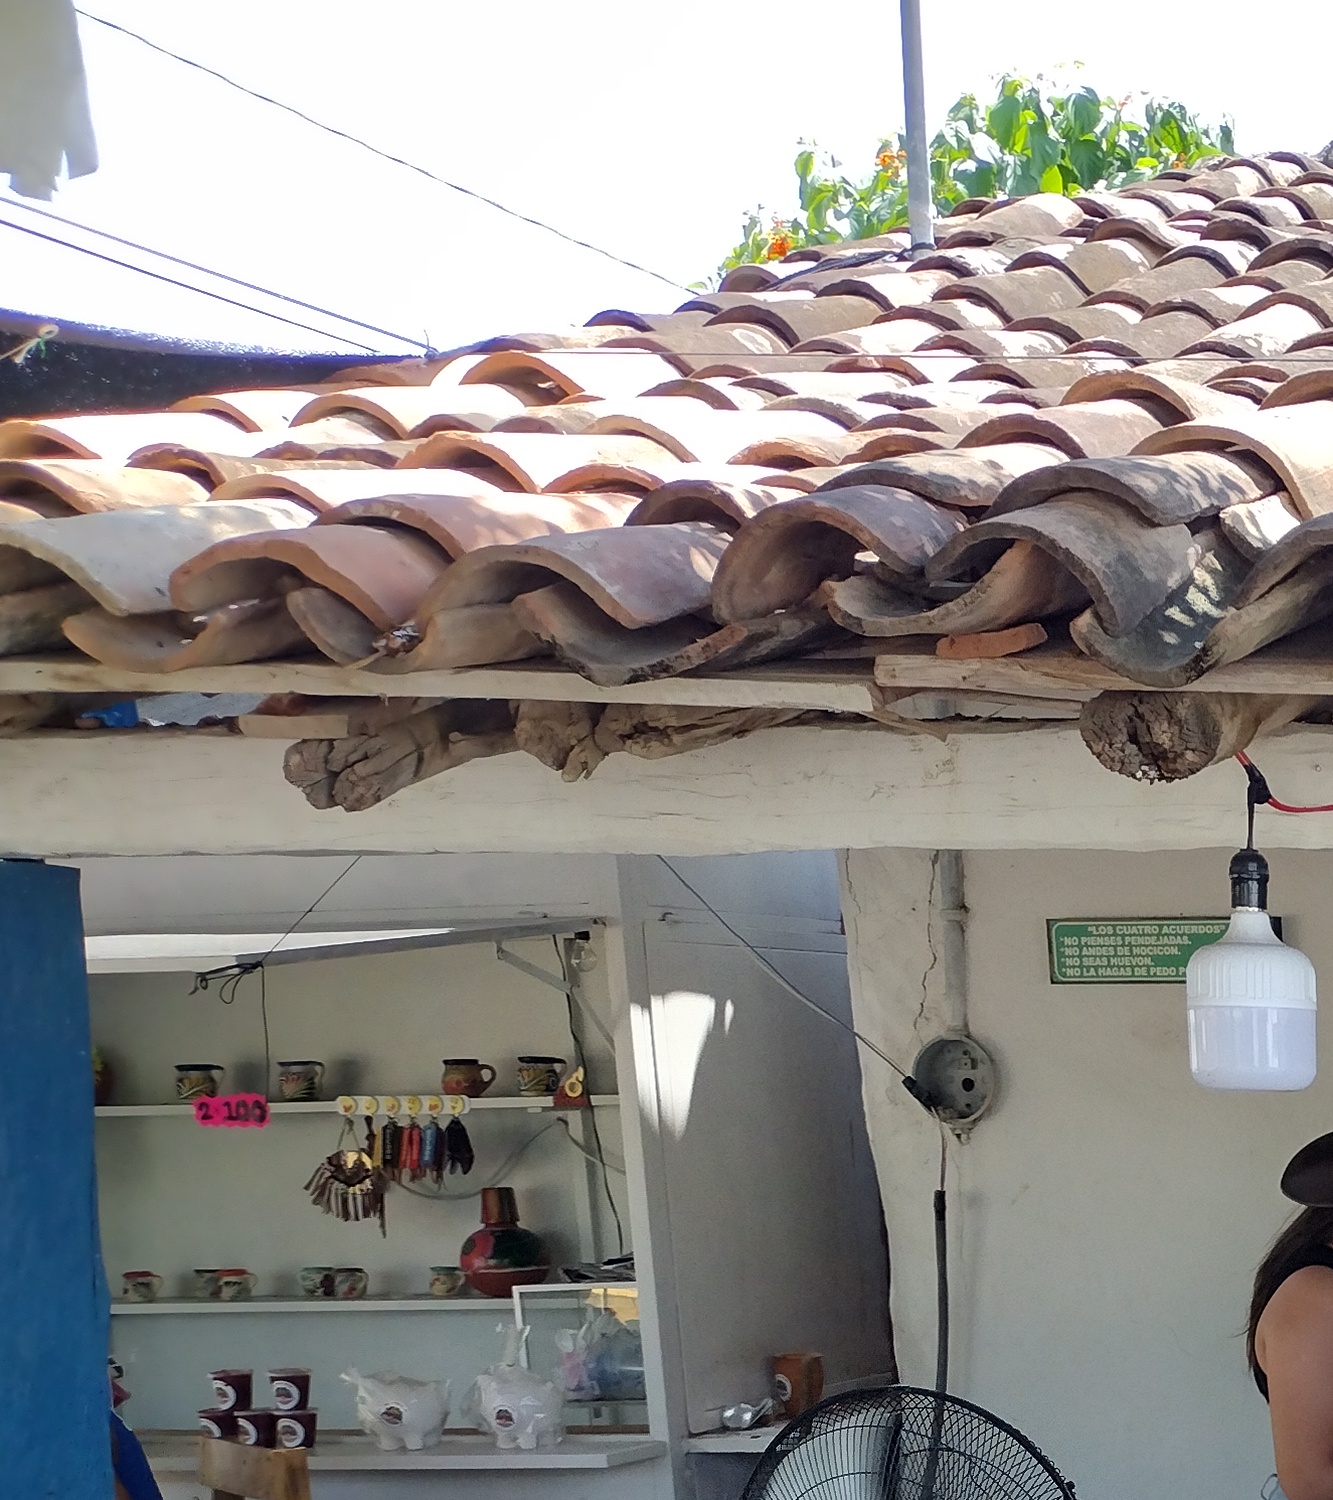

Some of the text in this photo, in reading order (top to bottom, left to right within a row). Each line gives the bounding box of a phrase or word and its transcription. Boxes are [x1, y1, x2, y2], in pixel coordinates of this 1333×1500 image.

[1116, 925, 1160, 935] CUATRO
[1080, 936, 1123, 946] PIENSES
[1124, 935, 1192, 946] PENDEJADAS.
[1081, 946, 1115, 957] ANDES
[1116, 946, 1131, 956] DE
[1082, 956, 1108, 966] SEAS
[1083, 967, 1097, 977] LA
[1098, 967, 1132, 977] HAGAS
[1134, 967, 1149, 977] DE
[1150, 966, 1177, 977] PEDO
